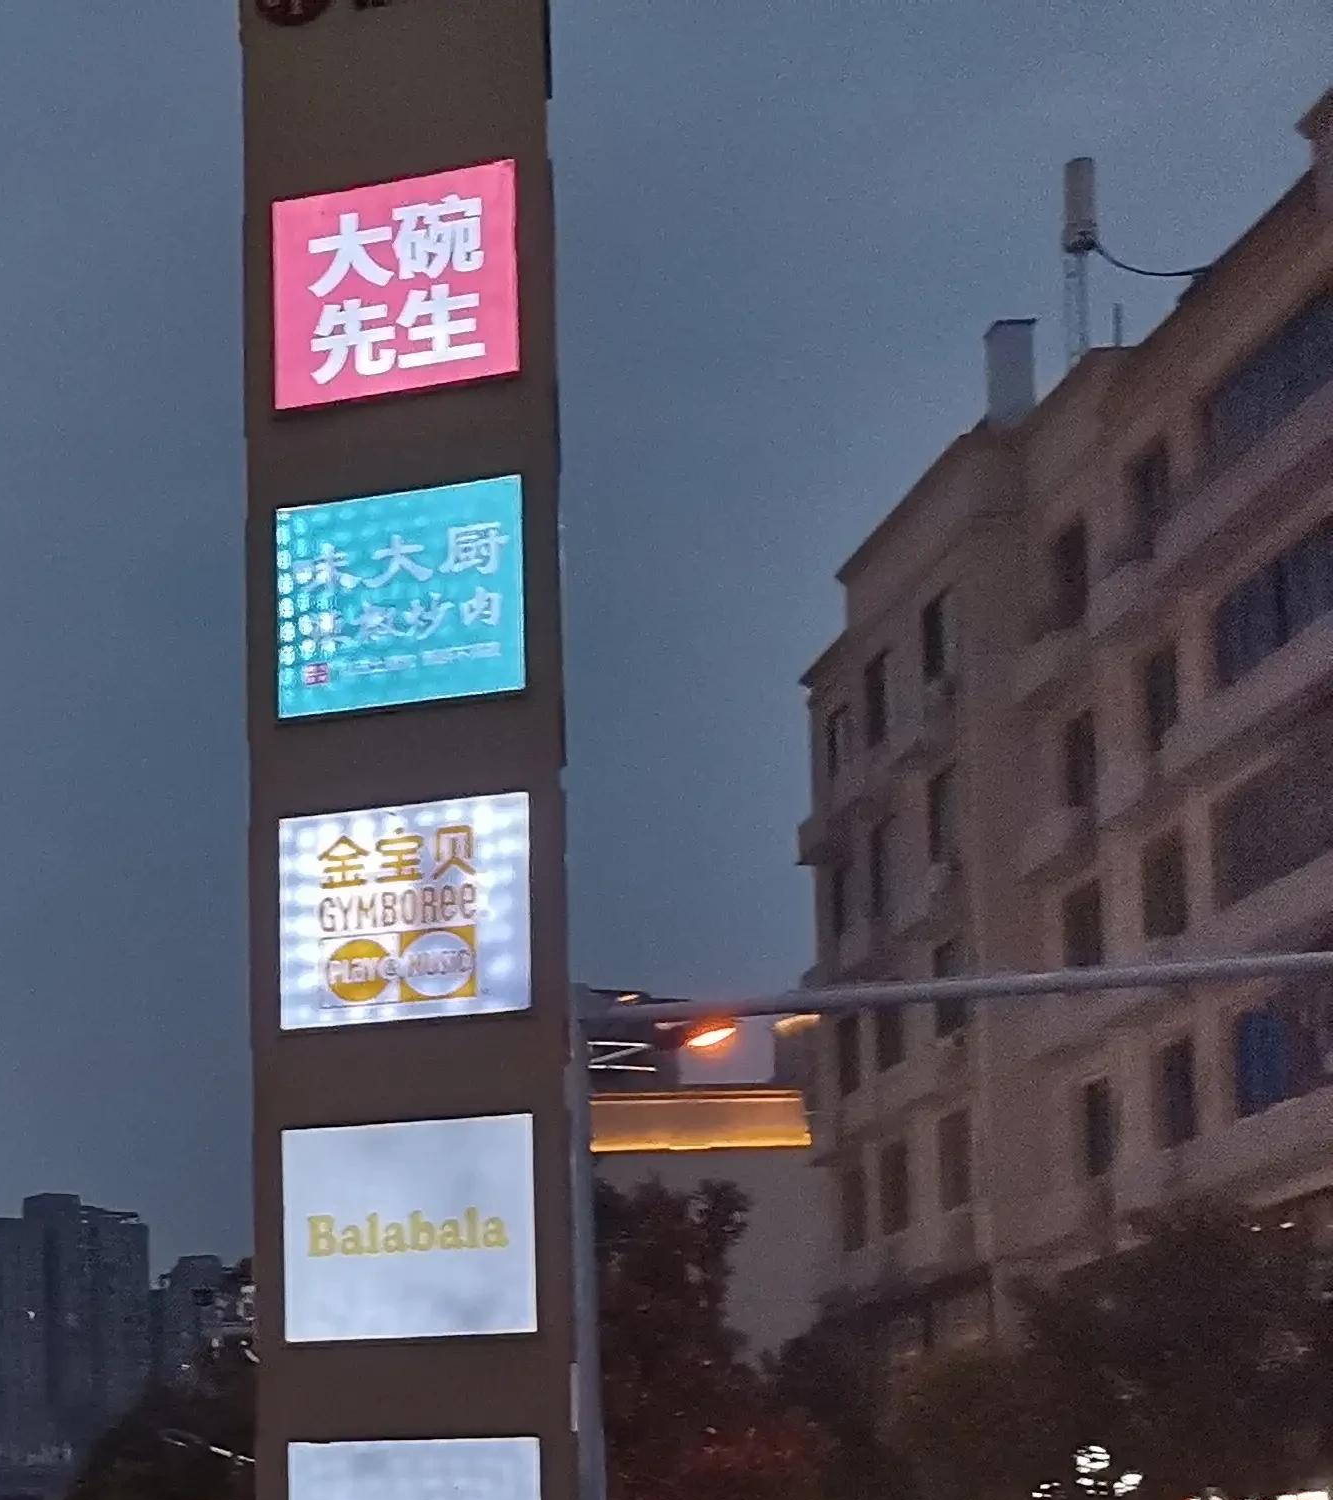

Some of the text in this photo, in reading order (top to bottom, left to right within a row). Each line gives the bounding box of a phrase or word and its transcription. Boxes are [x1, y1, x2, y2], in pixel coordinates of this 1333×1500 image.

[307, 194, 485, 298] 大碗
[309, 284, 486, 385] 先生
[317, 823, 477, 890] 金宝贝
[306, 1205, 509, 1258] Balabala
